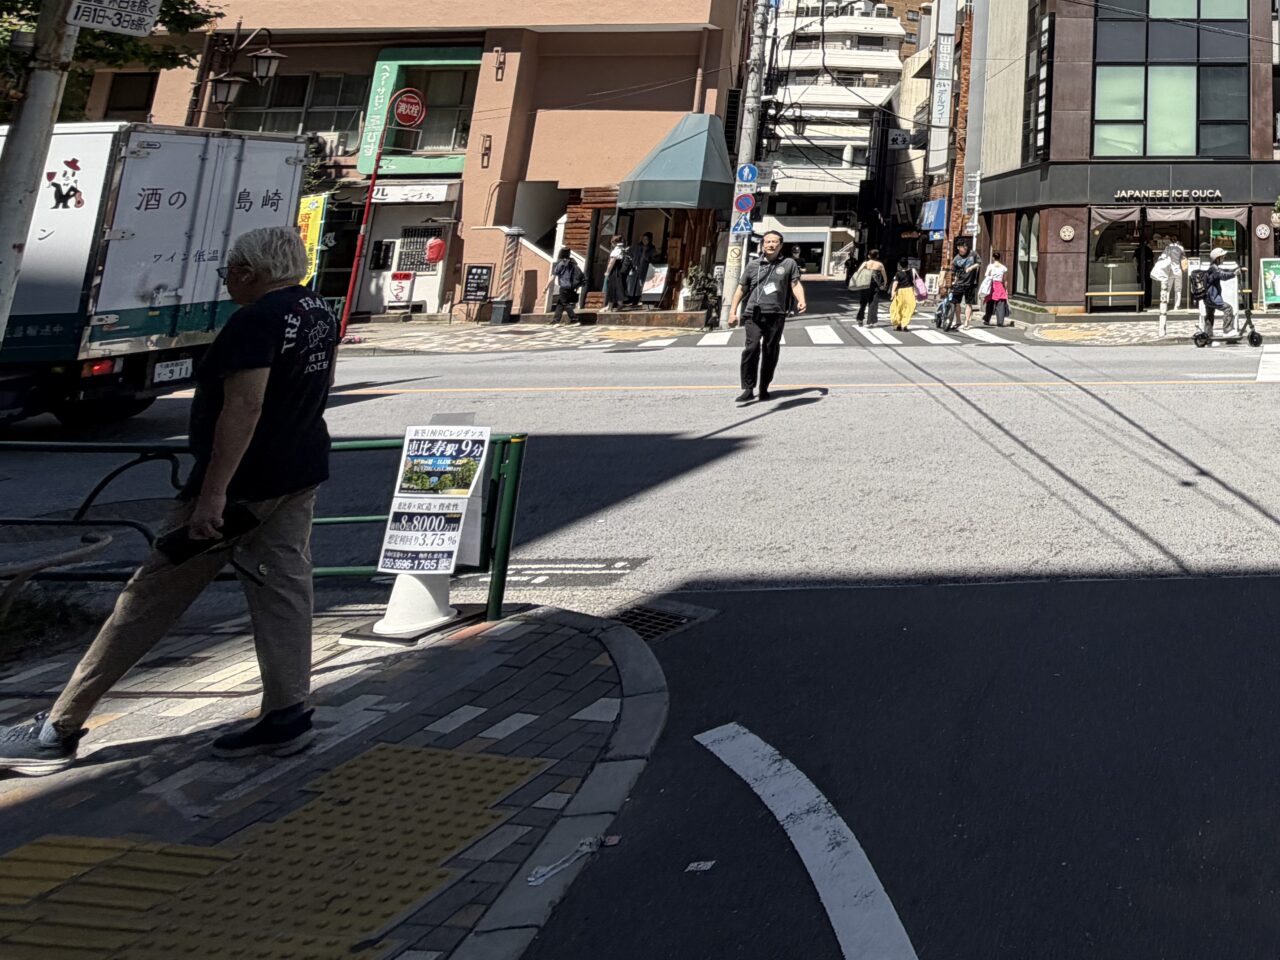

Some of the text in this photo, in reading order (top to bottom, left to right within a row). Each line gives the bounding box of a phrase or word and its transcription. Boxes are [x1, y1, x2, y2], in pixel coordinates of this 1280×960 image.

[397, 102, 420, 117] 消火栓
[1114, 189, 1222, 198] JAPANESE ICE OUCA
